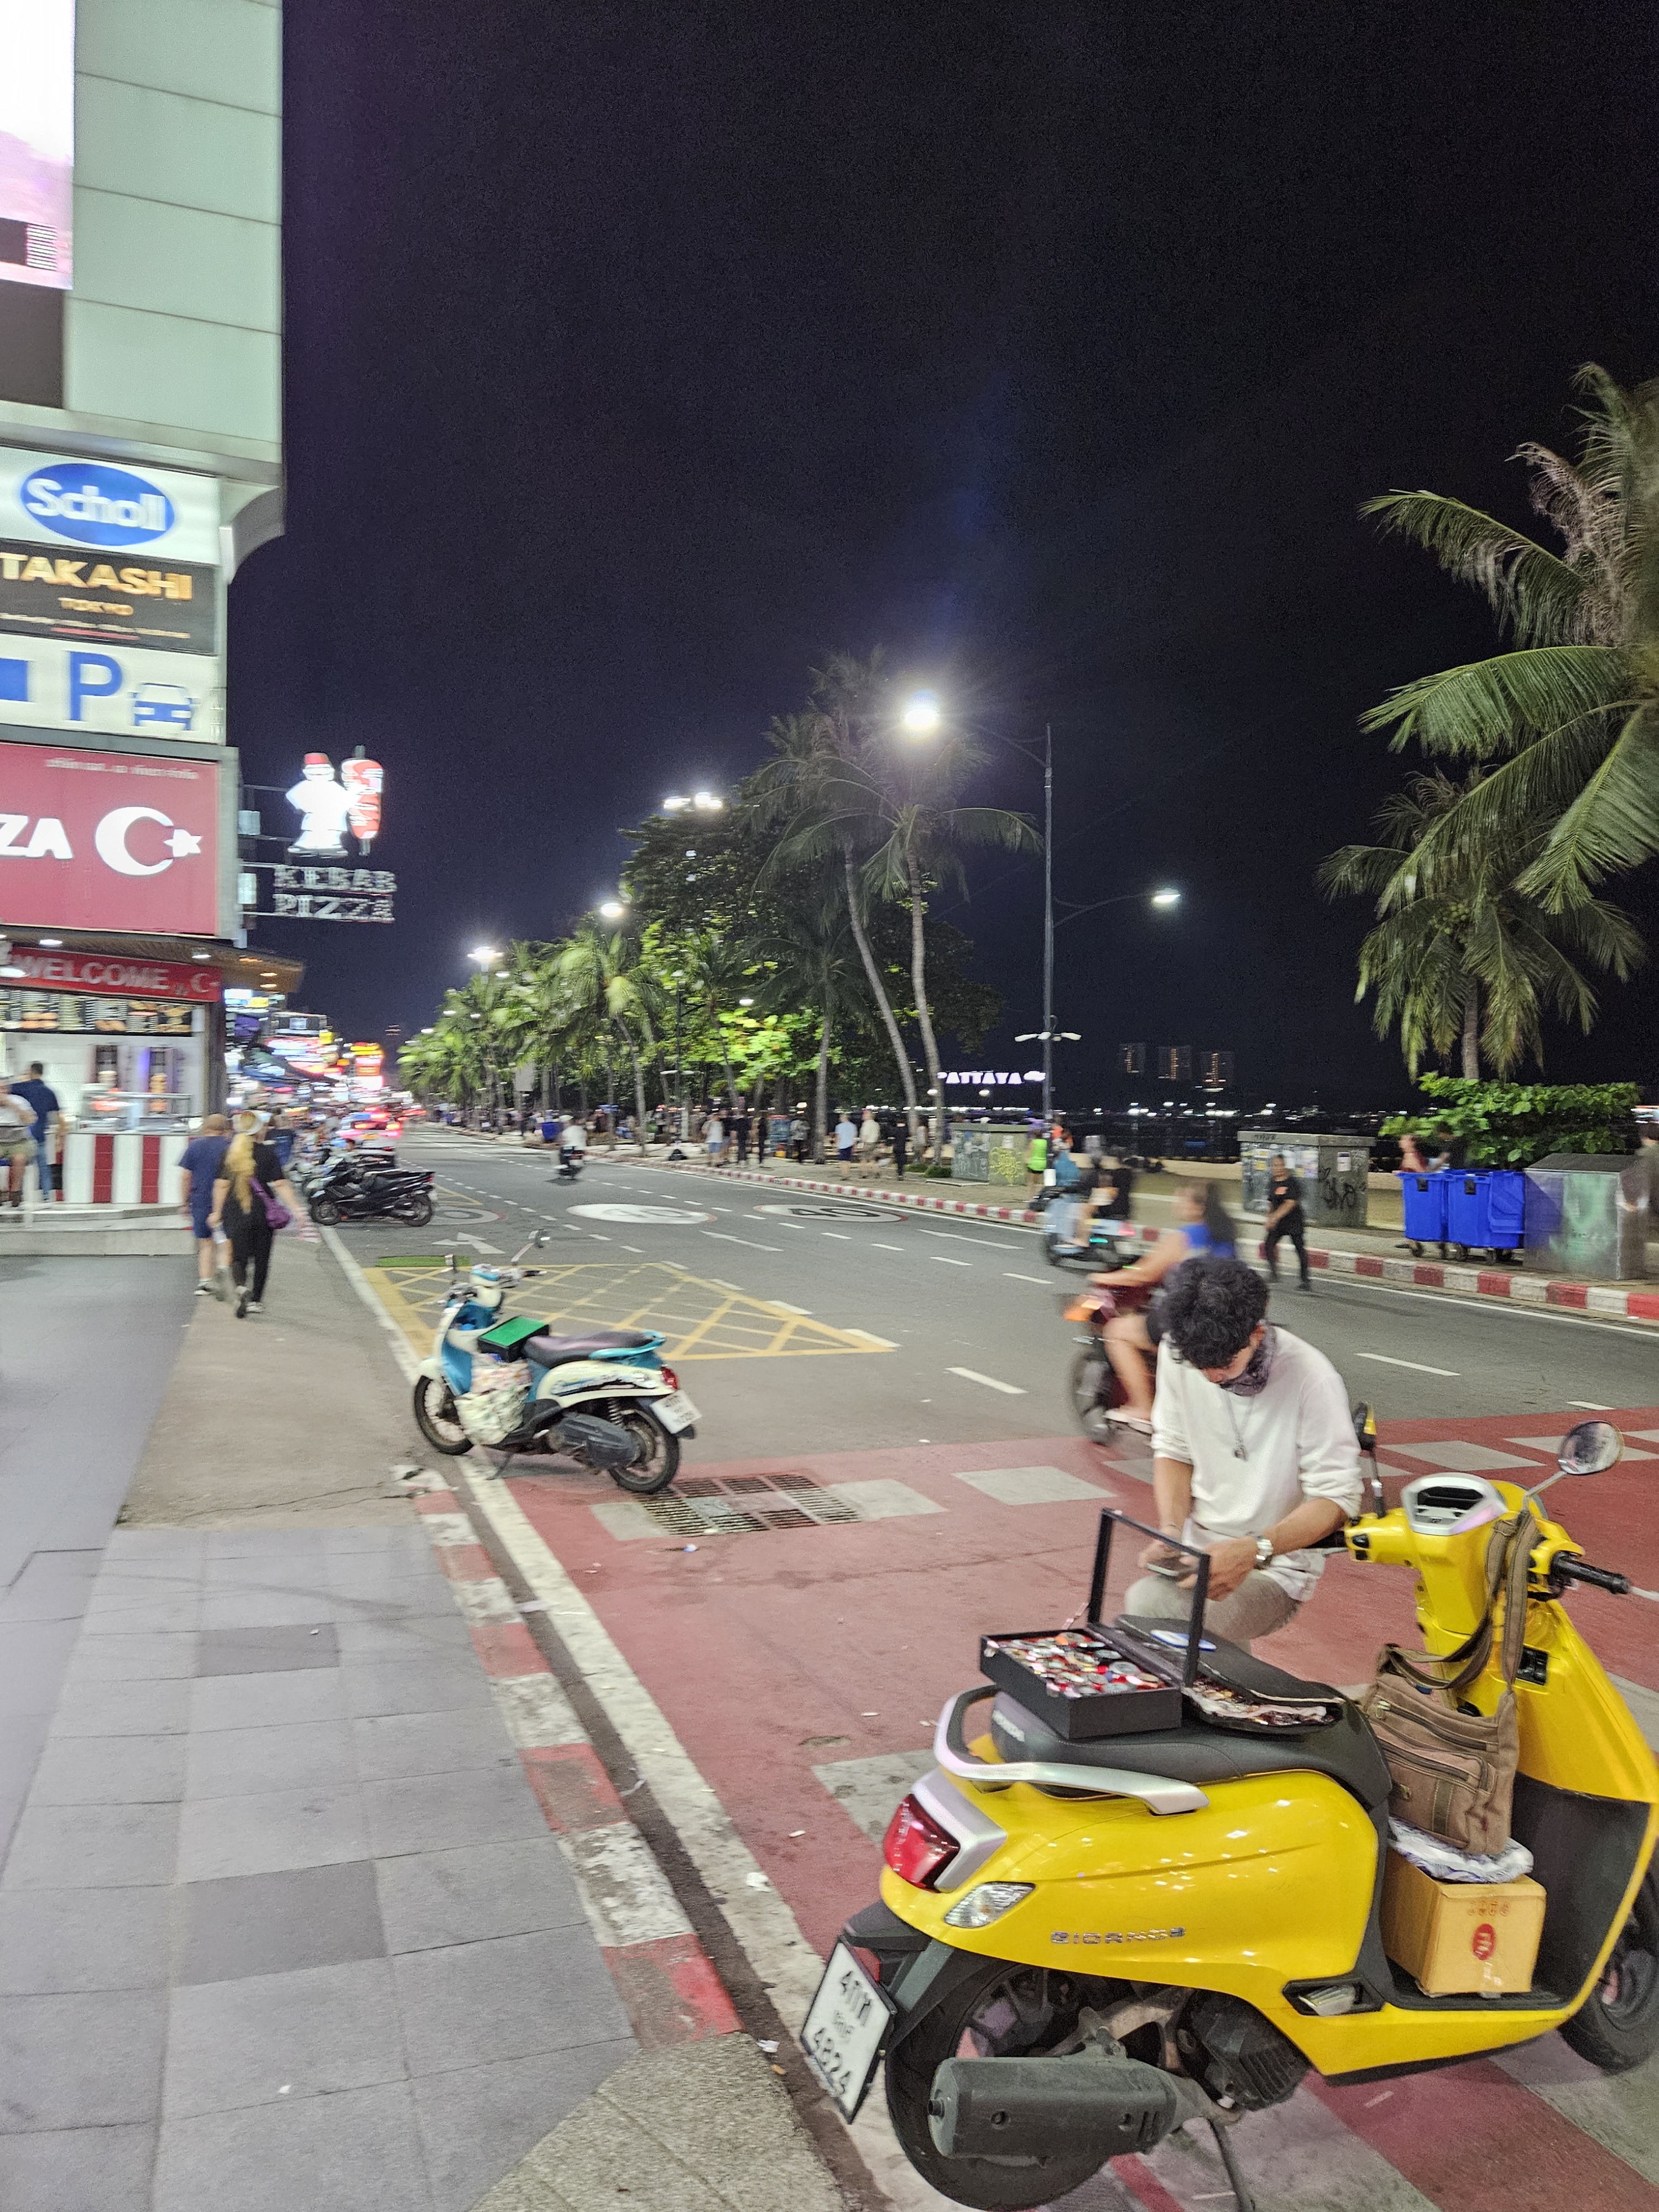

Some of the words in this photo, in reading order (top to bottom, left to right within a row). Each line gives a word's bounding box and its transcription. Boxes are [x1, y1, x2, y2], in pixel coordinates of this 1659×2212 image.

[27, 478, 166, 531] Scholl
[0, 552, 192, 601] TAKASHI
[69, 650, 123, 721] P
[272, 893, 396, 921] PIZZA
[10, 954, 171, 990] WELCOME
[937, 1071, 1022, 1084] PATTAYA
